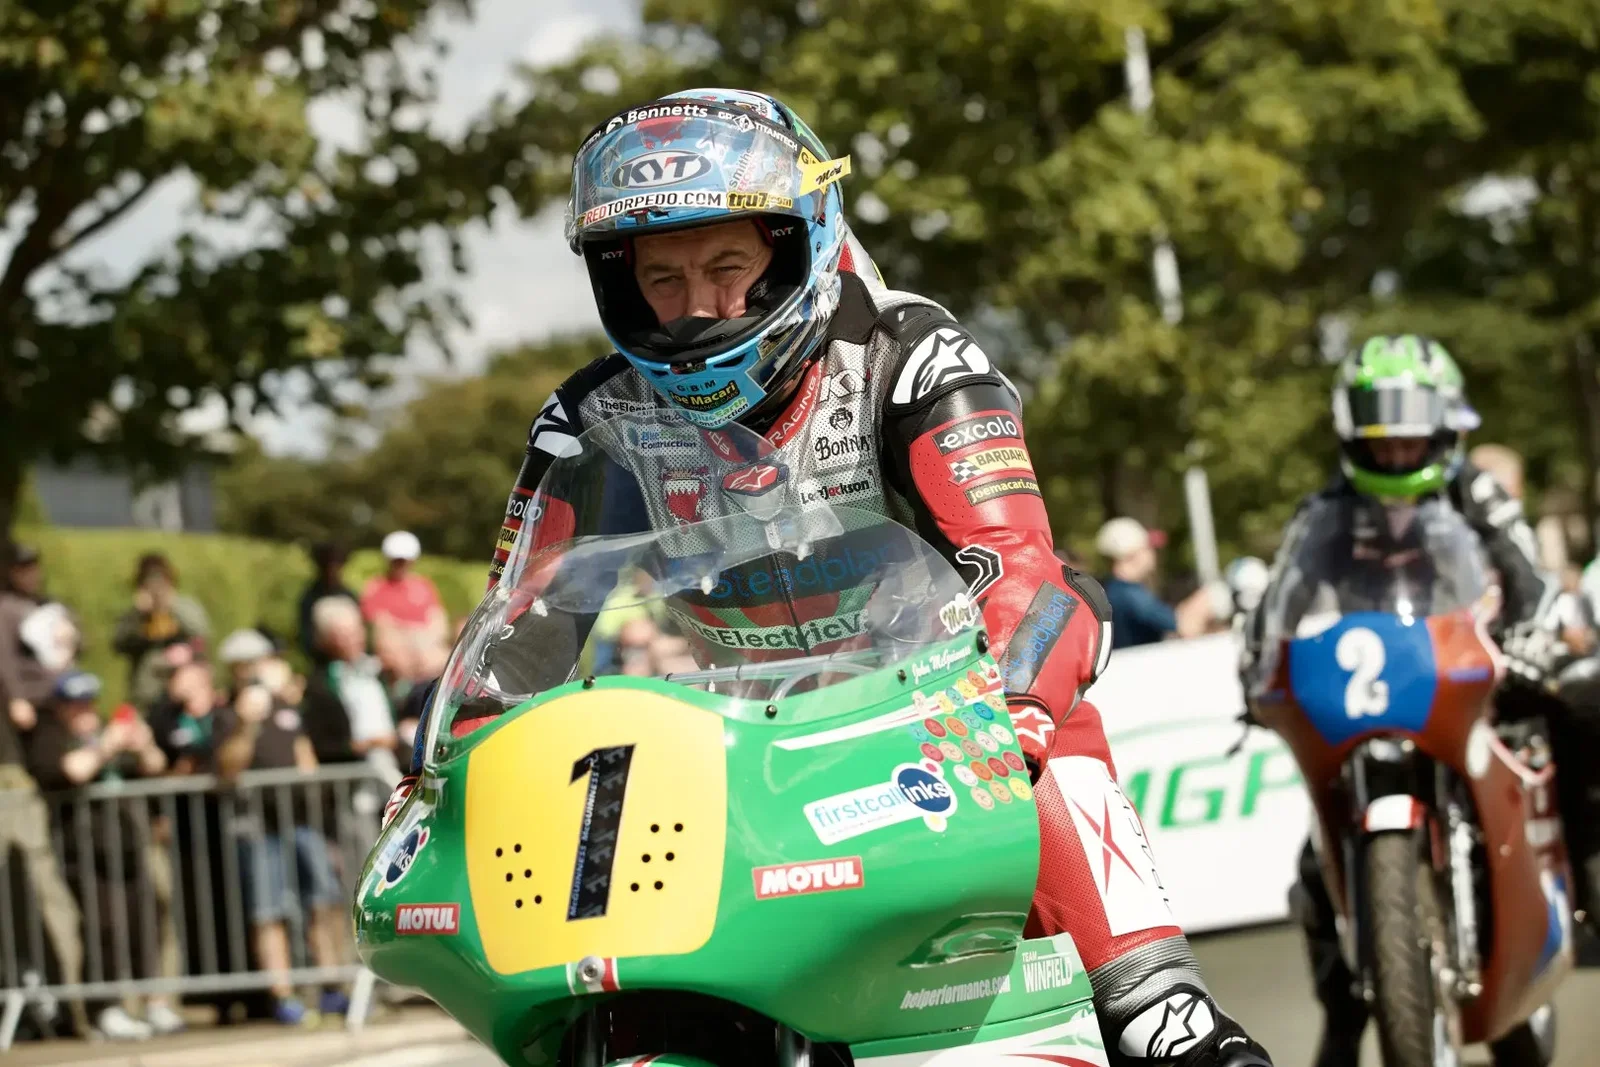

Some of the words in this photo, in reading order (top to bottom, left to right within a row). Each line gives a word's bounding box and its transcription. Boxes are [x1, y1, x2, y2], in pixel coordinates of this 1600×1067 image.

[627, 104, 708, 125] Bennetts
[755, 121, 798, 152] TITANTECH
[620, 154, 696, 187] KYT
[585, 192, 721, 226] REDTORPEDO.COM
[771, 226, 795, 237] KYT
[601, 249, 625, 261] KYT
[689, 382, 736, 406] Macari
[768, 375, 817, 446] RACING
[939, 416, 1018, 450] excolo
[975, 449, 1028, 467] BARDAHL
[969, 478, 1040, 503] joemacari.com
[1335, 626, 1390, 720] 2
[565, 742, 636, 922] 1
[760, 861, 859, 895] MOTUL
[397, 907, 456, 930] MOTUL
[1021, 950, 1038, 961] TEAM
[1023, 957, 1073, 993] WINFIELD
